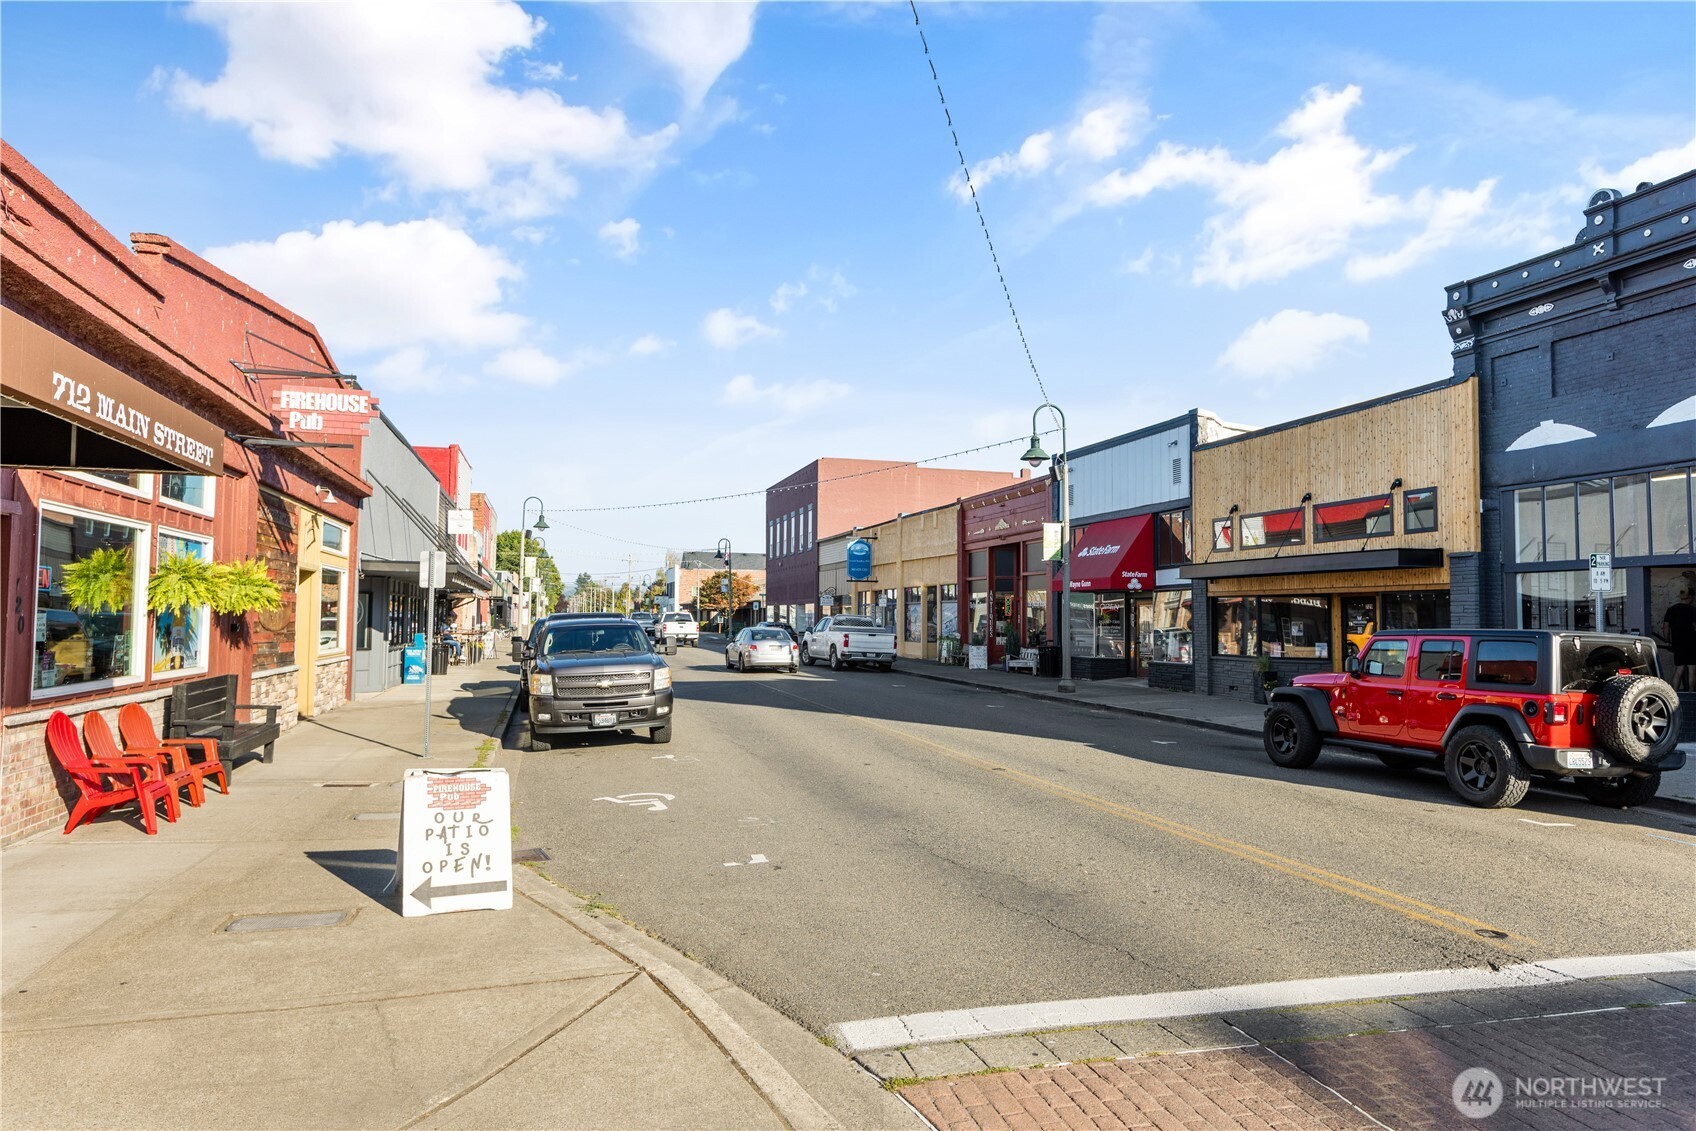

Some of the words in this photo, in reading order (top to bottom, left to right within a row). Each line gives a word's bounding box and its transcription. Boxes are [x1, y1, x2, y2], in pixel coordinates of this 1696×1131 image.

[280, 390, 369, 414] FIREHOUSE
[53, 371, 91, 414] 712
[96, 391, 151, 439] MAIN
[153, 421, 214, 467] STREET
[289, 411, 324, 431] Pub
[1591, 555, 1596, 566] 2
[1081, 580, 1092, 588] Gunn
[433, 783, 481, 793] FIREHOUSE
[434, 811, 494, 825] OUR
[425, 824, 489, 844] PATIO
[446, 842, 470, 856] IS
[422, 853, 491, 878] OPEN!
